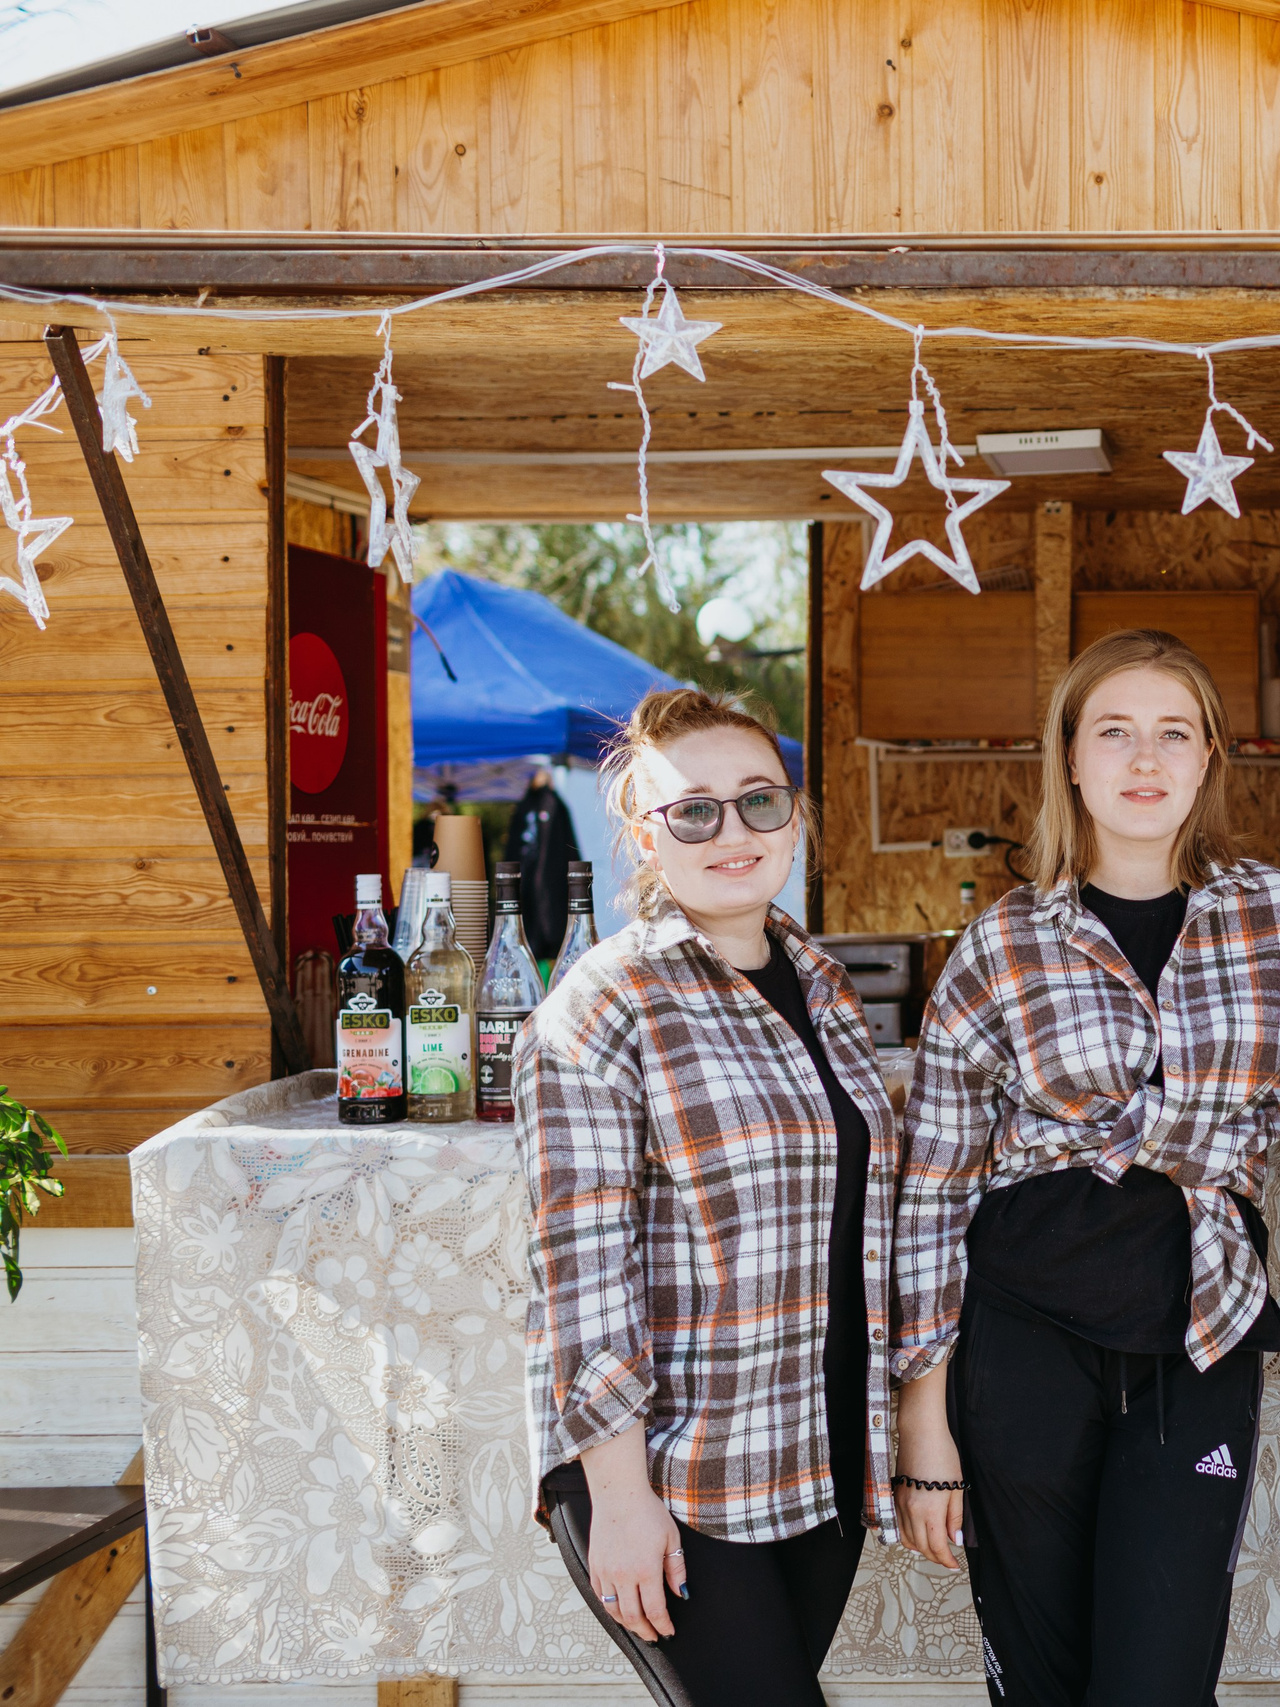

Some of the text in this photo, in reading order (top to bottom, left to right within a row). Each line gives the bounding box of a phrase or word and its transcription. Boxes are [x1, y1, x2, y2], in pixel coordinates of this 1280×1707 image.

[342, 1014, 387, 1028] ESKO
[411, 1008, 456, 1023] ESKO
[342, 1048, 390, 1058] GRENADINE
[422, 1043, 444, 1052] LIME
[1195, 1461, 1237, 1479] adidas
